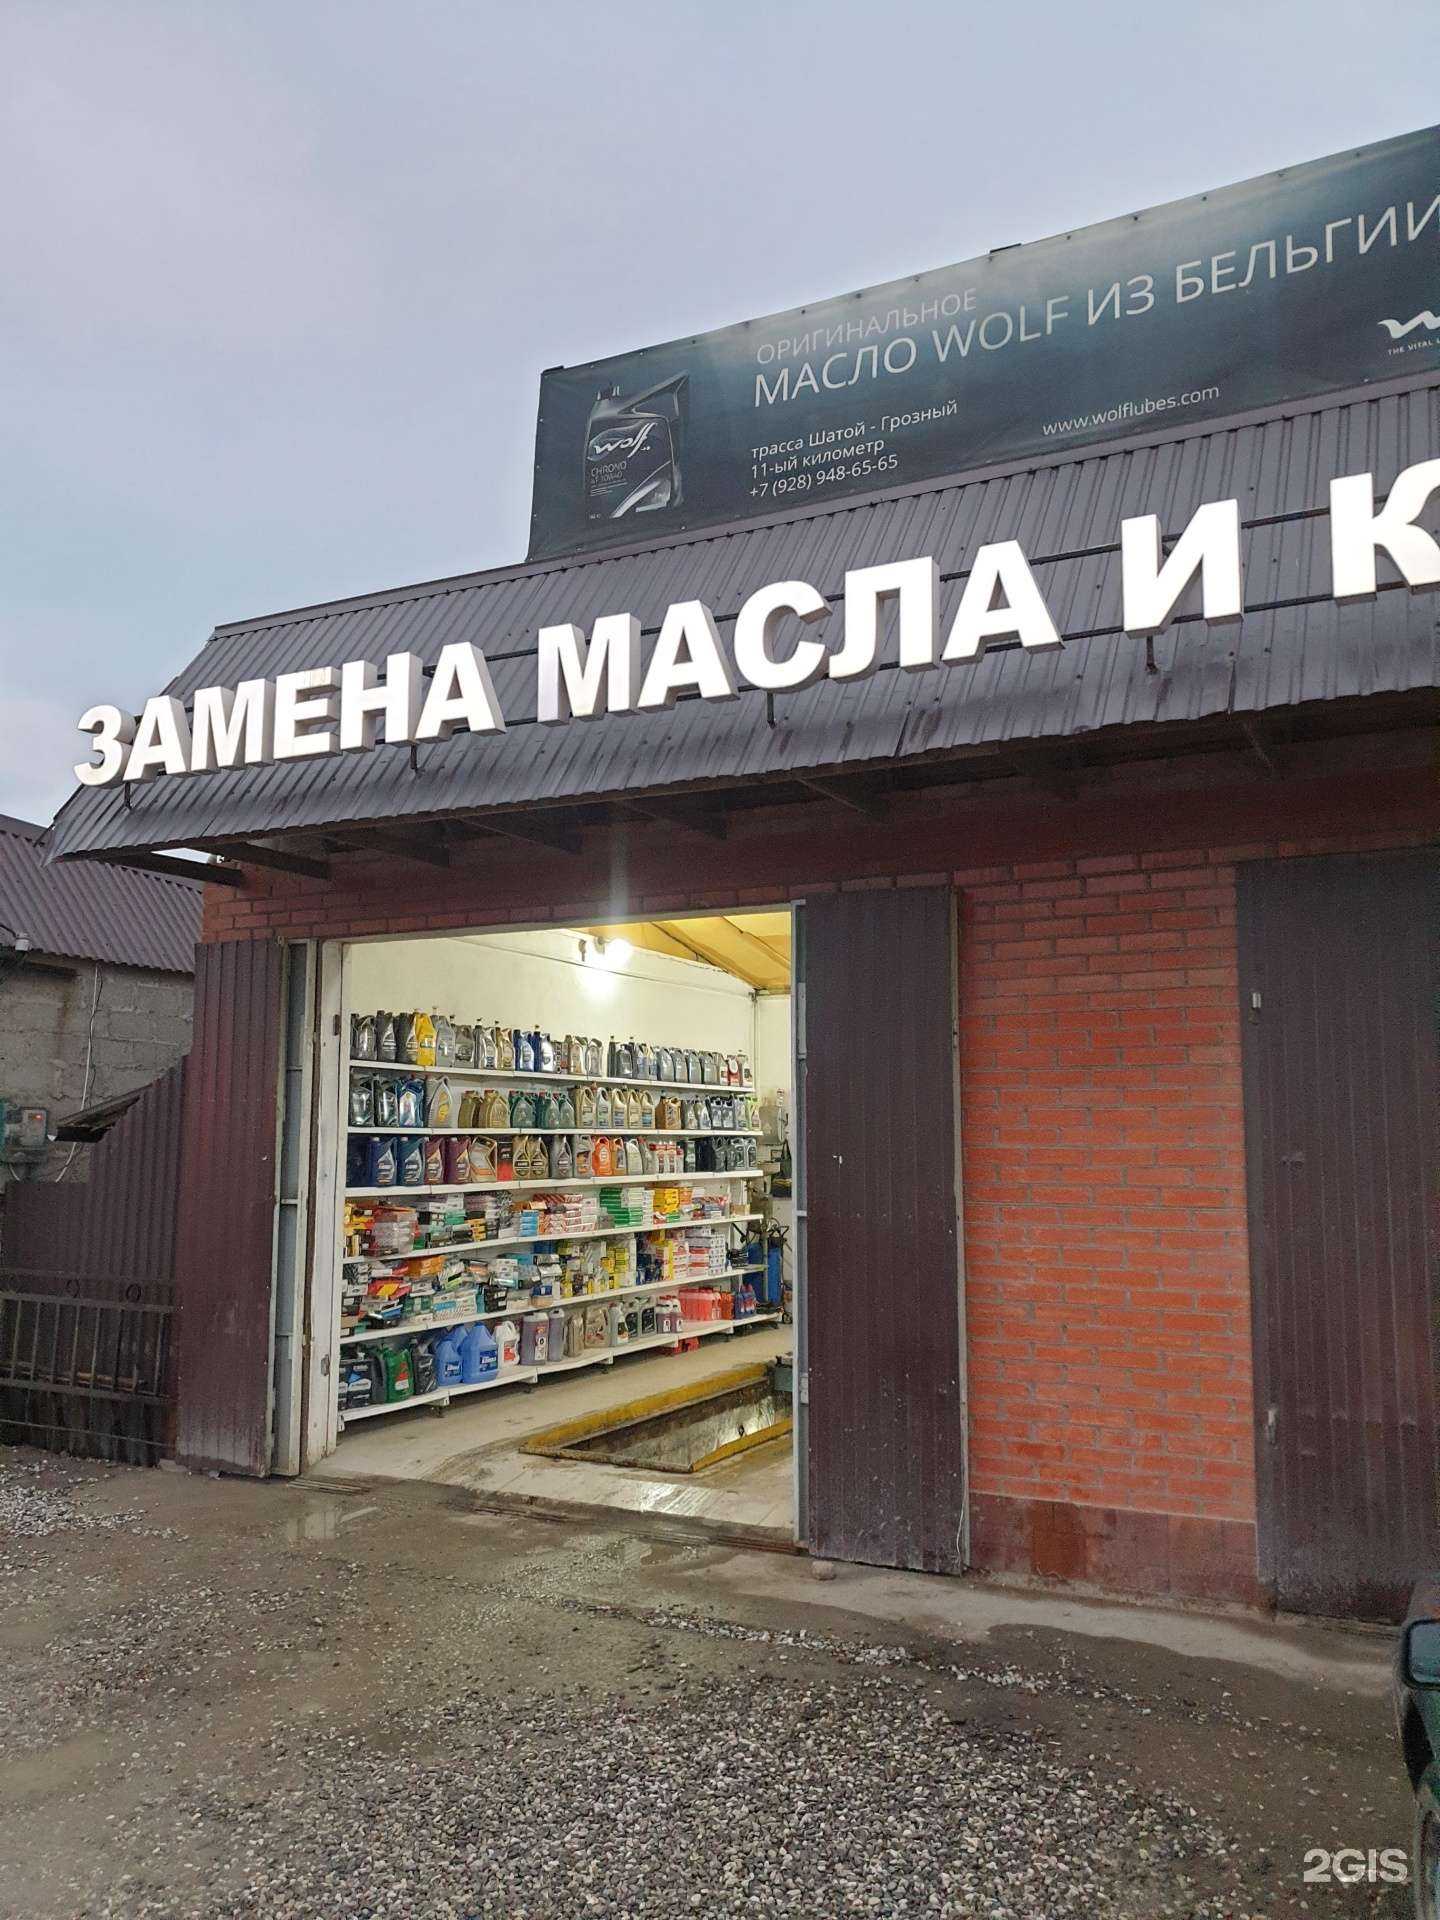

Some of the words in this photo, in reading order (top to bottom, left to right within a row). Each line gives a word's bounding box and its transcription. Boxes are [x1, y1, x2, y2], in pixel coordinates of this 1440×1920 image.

[754, 337, 917, 407] МАСЛО
[932, 295, 1069, 362] WOLF
[1087, 274, 1154, 326] ИЗ
[1176, 194, 1440, 303] БЕЛЬГИИ
[756, 287, 976, 364] ОРИГИНАЛЬНОЕ
[751, 438, 803, 461] трасса
[809, 421, 866, 447] Шатой
[881, 400, 958, 432] Грозный
[1042, 385, 1219, 436] www.wolflubes.com
[750, 484, 768, 498] +7
[772, 474, 812, 497] (928)
[816, 454, 898, 485] 948-65-65
[751, 456, 798, 479] 11-ый
[803, 440, 885, 467] километр
[73, 641, 505, 787] ЗАМЕНА
[537, 539, 1064, 727] МАСЛА
[1121, 498, 1244, 639] И
